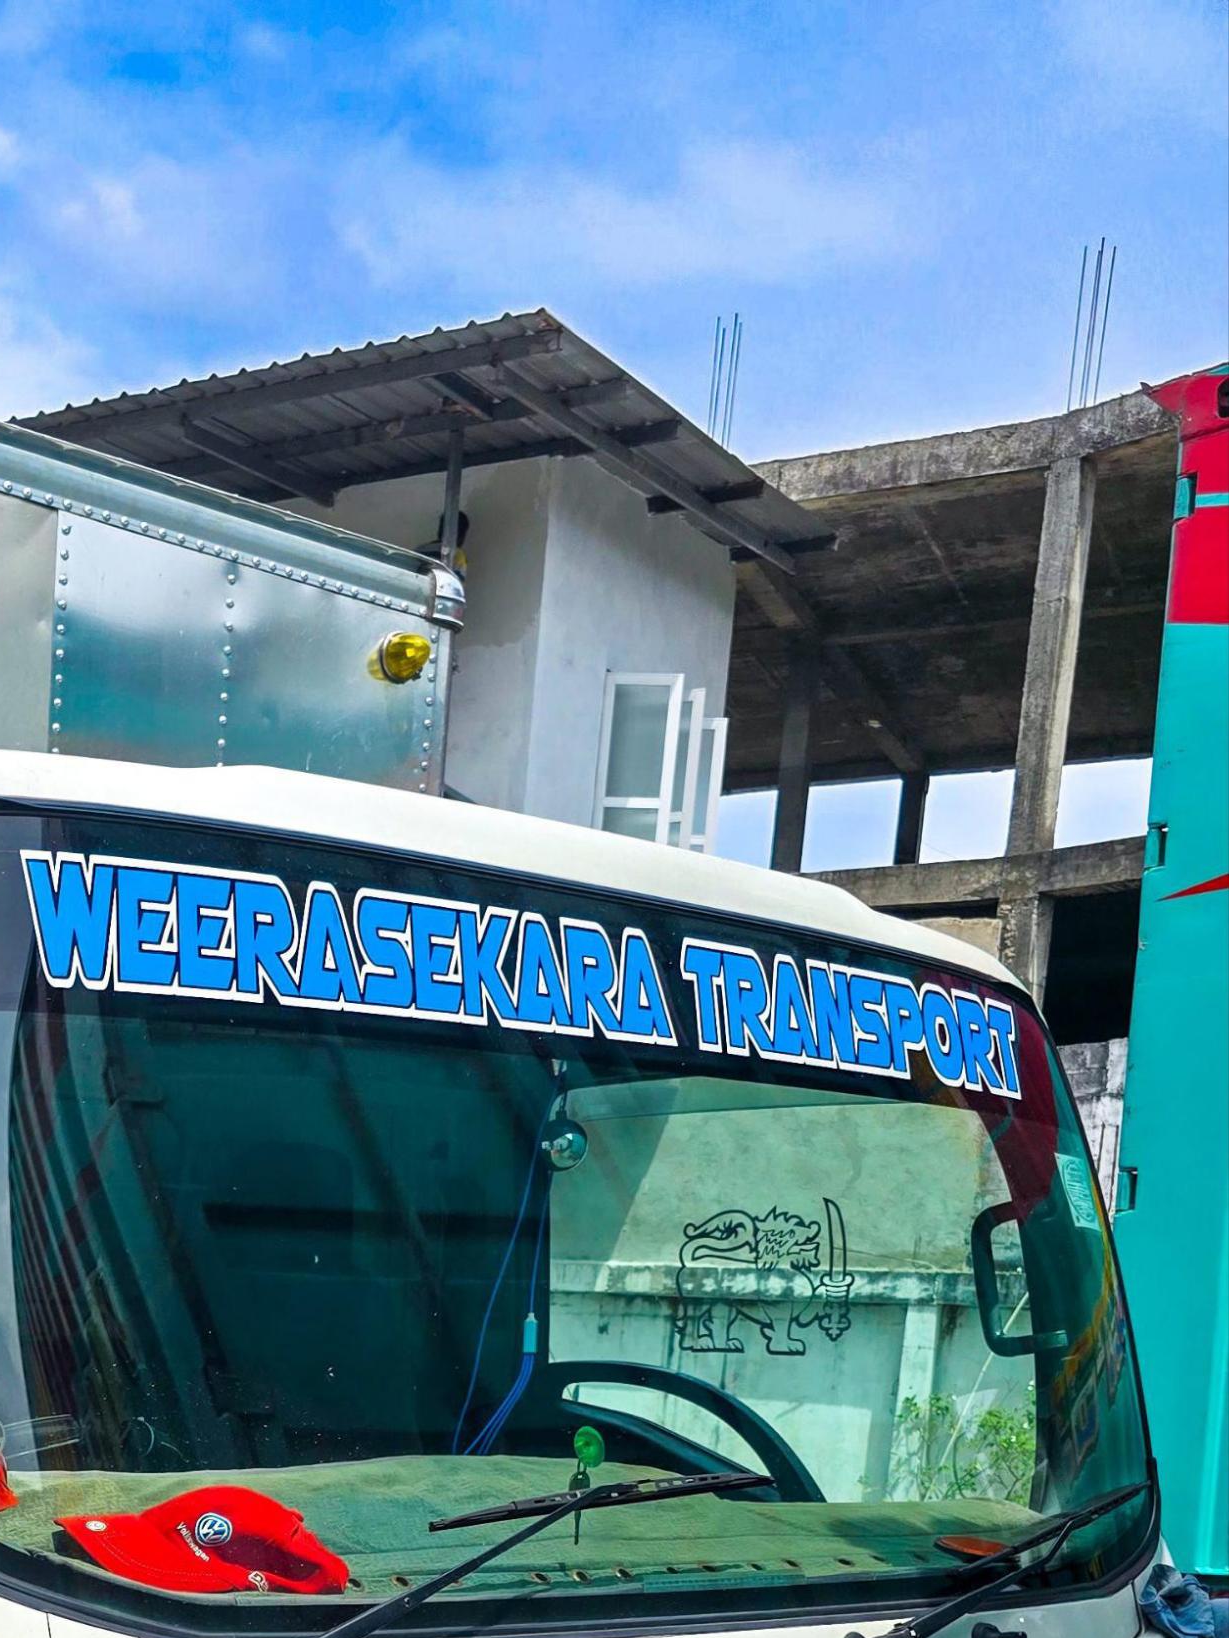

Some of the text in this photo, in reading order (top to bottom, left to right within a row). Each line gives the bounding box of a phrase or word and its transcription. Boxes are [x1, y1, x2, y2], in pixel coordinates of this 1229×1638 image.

[21, 851, 1022, 1099] WEERASEKARA TRANSPORT
[176, 1521, 210, 1562] Volkswagen
